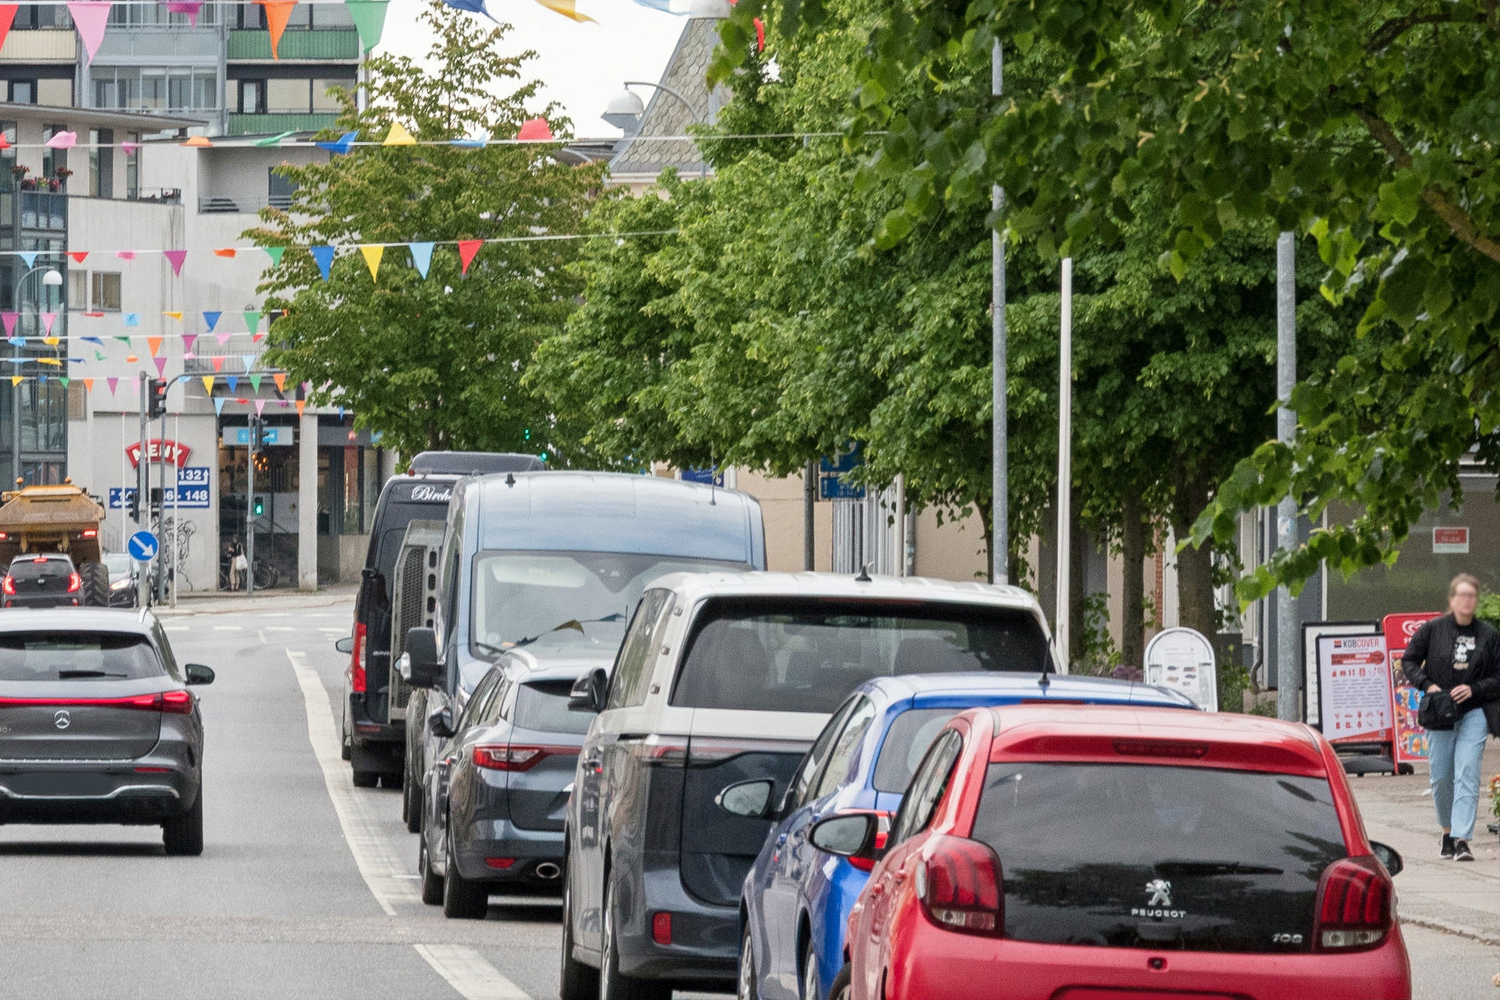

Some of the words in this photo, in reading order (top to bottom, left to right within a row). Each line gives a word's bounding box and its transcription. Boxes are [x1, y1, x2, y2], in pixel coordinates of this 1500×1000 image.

[178, 469, 202, 480] 132
[185, 490, 208, 501] 148
[1131, 908, 1187, 918] PEUGEOT
[1271, 933, 1303, 944] 108
